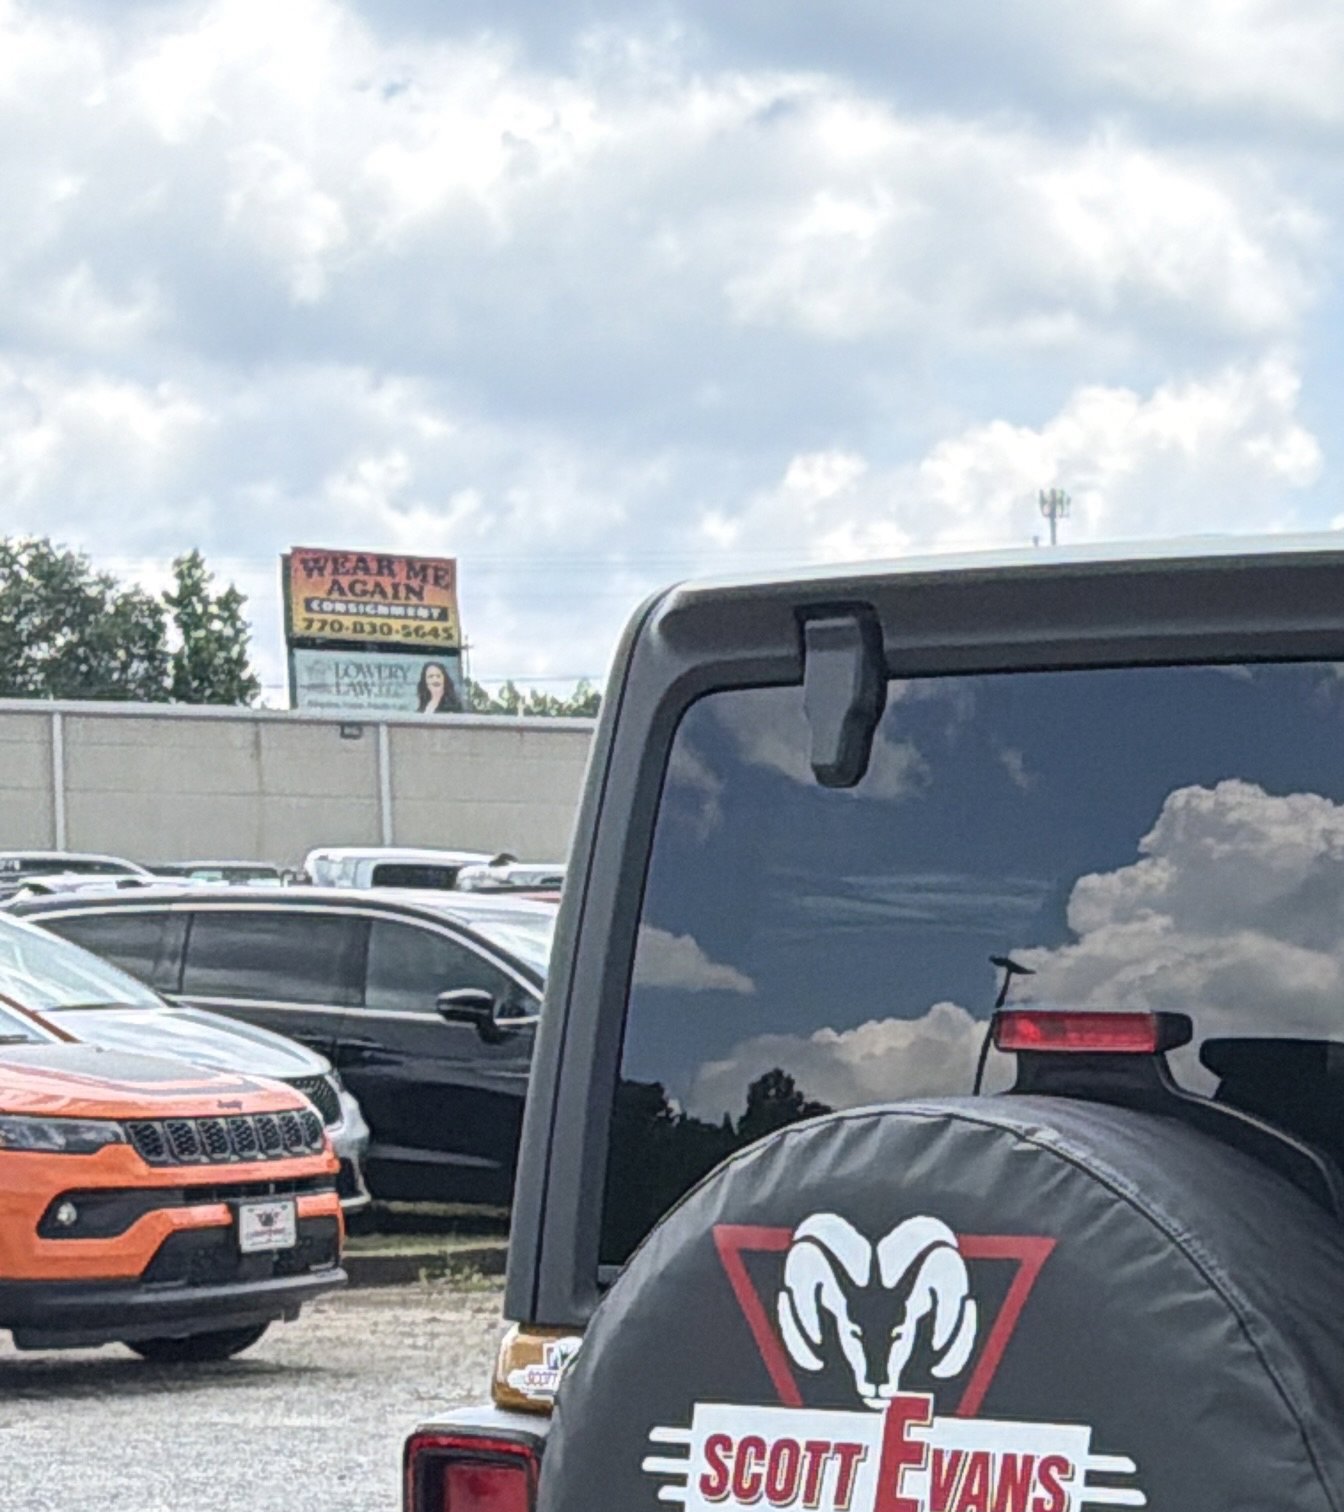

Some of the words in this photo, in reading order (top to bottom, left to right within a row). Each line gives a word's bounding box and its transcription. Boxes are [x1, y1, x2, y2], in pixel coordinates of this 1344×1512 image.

[301, 556, 394, 578] WEAR
[405, 560, 450, 590] ME
[326, 578, 425, 601] AGAIN
[310, 600, 441, 618] CONSIGNMENT
[698, 1432, 867, 1512] SCOTT
